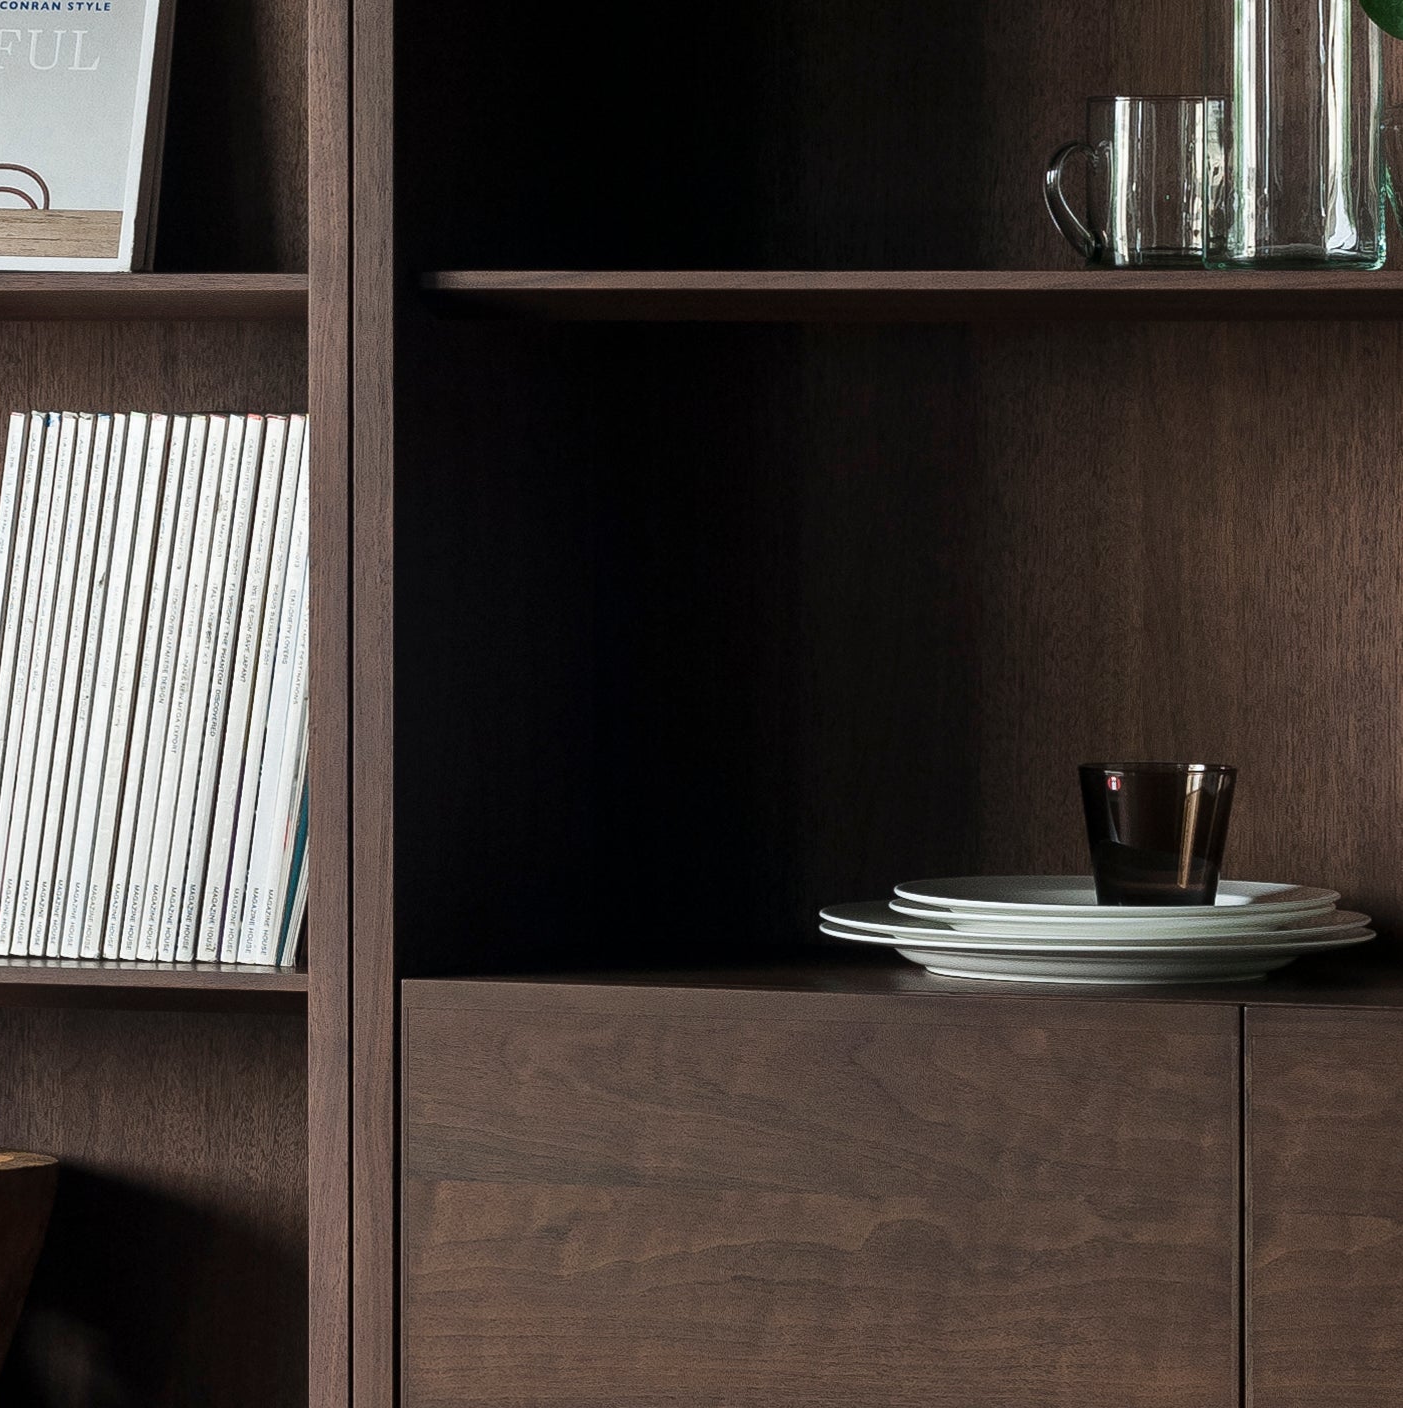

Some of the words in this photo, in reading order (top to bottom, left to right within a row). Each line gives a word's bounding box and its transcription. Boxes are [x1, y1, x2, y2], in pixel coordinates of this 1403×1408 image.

[0, 0, 62, 11] CONRAN
[67, 2, 112, 12] STYLE
[282, 635, 290, 664] LOVERS
[158, 675, 167, 704] DESIGN
[171, 724, 180, 753] EXPORT
[3, 878, 12, 915] MAGAZINE
[21, 880, 29, 917] MAGAZINE
[38, 881, 47, 917] MAGAZINE
[54, 879, 63, 917] MAGAZINE
[71, 881, 80, 919] MAGAZINE
[88, 884, 98, 922] MAGAZINE
[111, 883, 120, 920] MAGAZINE
[130, 884, 140, 922] MAGAZINE
[149, 884, 159, 922] MAGAZINE
[167, 886, 177, 924] MAGAZINE
[186, 883, 196, 922] MAGAZINE
[209, 886, 219, 925] MAGAZINE
[230, 887, 239, 926] MAGAZINE
[249, 887, 259, 925] MAGAZINE
[264, 889, 274, 927] MAGAZINE
[0, 917, 8, 943] HOUSE
[17, 919, 25, 944] HOUSE
[50, 919, 58, 944] HOUSE
[84, 924, 92, 950] HOUSE
[126, 924, 134, 950] HOUSE
[145, 924, 154, 949] HOUSE
[163, 927, 171, 953] HOUSE
[182, 924, 191, 949] HOUSE
[226, 928, 234, 953] HOUSE
[245, 927, 254, 953] HOUSE
[261, 929, 269, 955] HOUSE
